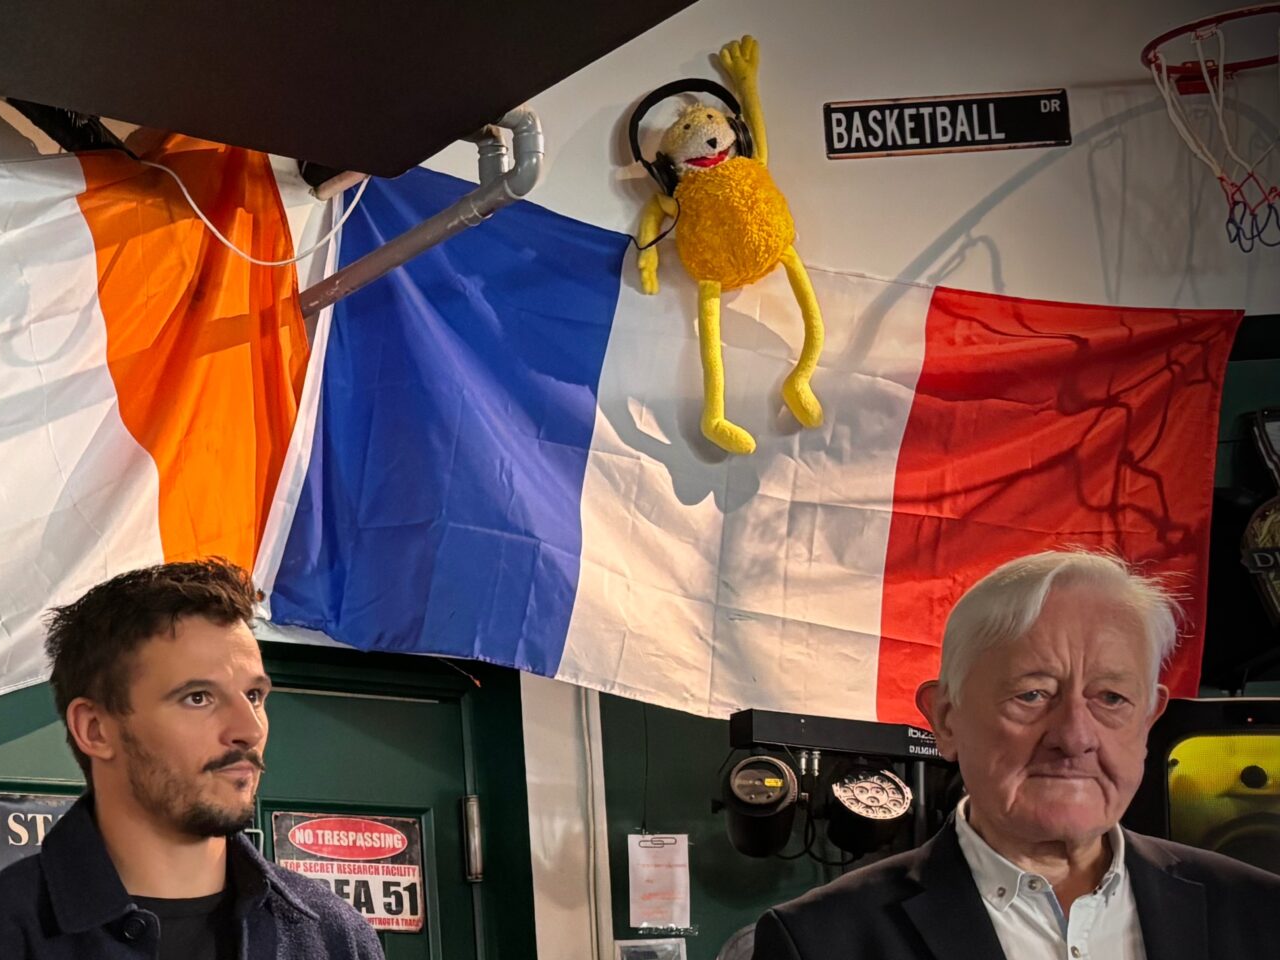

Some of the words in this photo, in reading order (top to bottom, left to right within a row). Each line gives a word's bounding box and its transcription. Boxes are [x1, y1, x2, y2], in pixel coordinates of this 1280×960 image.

[831, 102, 1006, 149] BASKETBALL
[1040, 99, 1061, 113] DR
[7, 812, 64, 846] ST
[295, 828, 314, 844] NO
[316, 829, 403, 849] TRESPASSING
[283, 862, 301, 873] TOP
[303, 862, 334, 874] SECRET
[337, 863, 380, 876] RESEARCH
[381, 865, 417, 877] FACILITY
[320, 878, 375, 915] EA
[382, 880, 419, 916] 51
